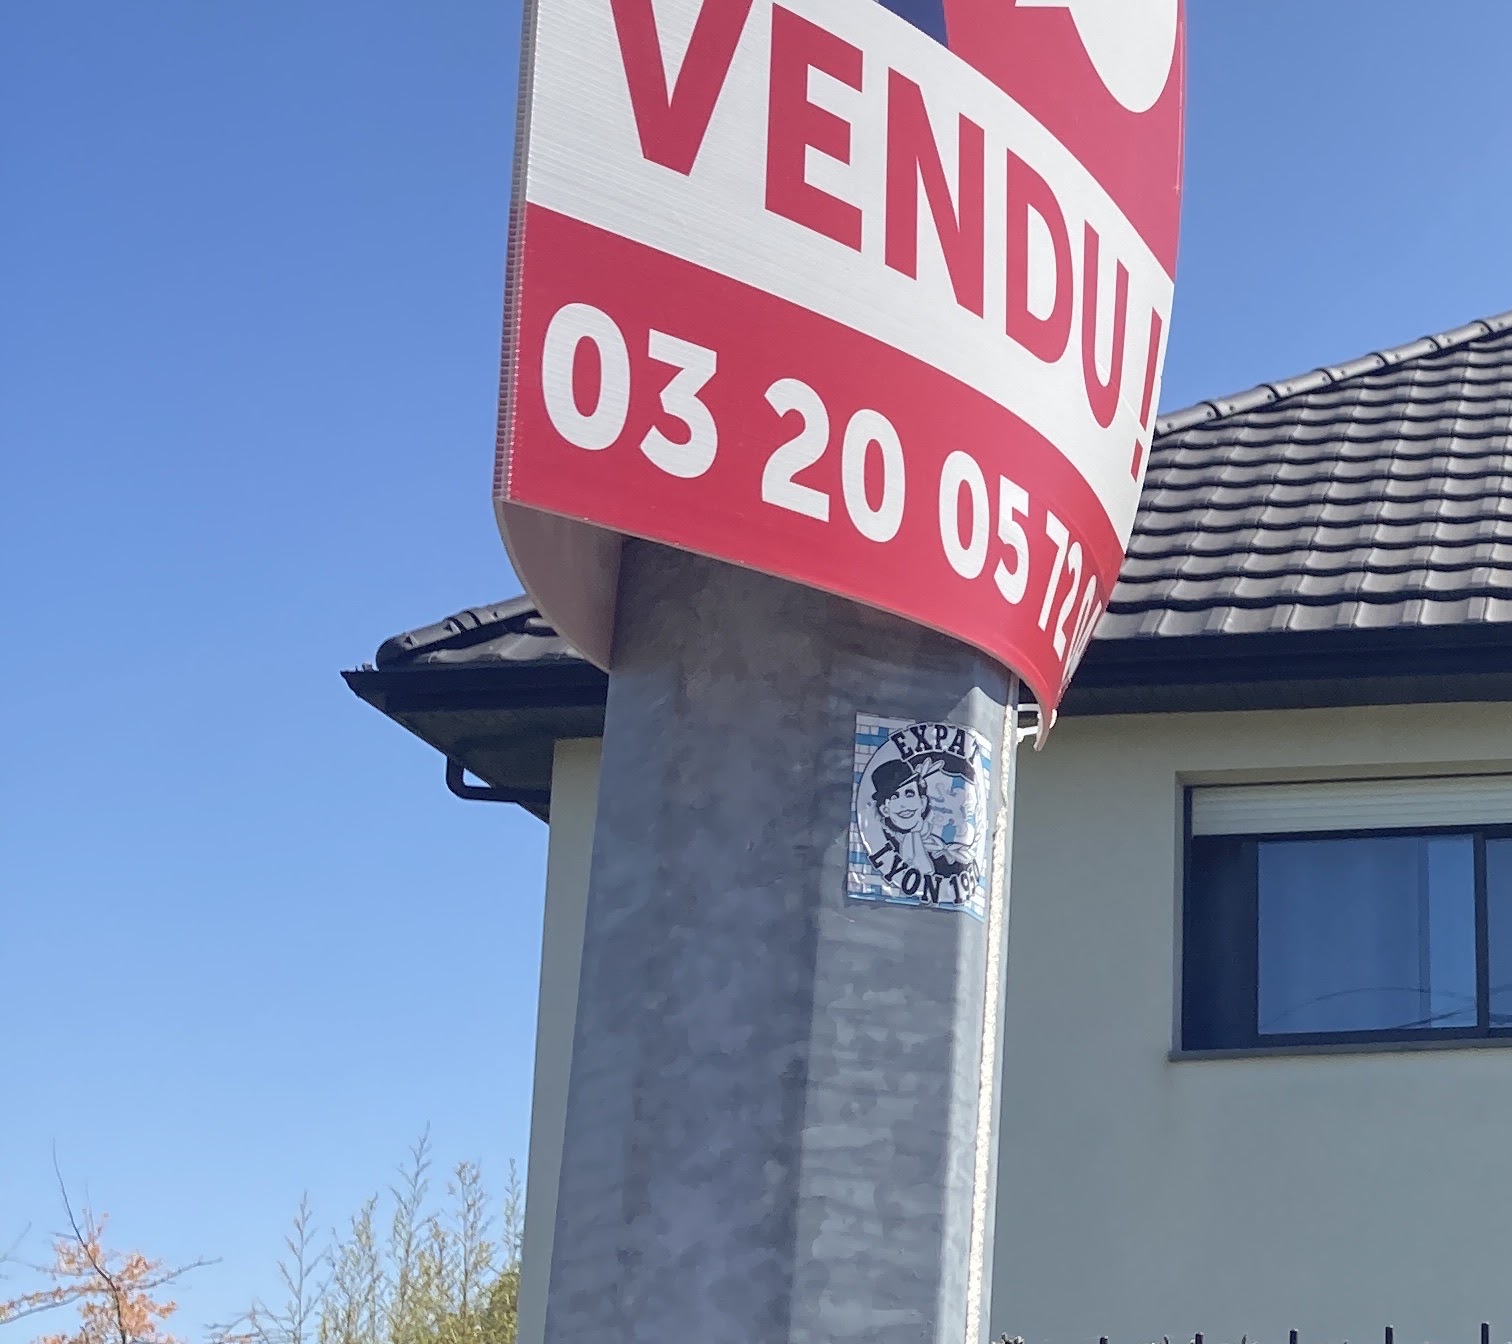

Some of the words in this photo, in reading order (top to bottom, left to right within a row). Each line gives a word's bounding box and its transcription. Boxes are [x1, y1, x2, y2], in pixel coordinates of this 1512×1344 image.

[541, 301, 719, 480] 03
[761, 377, 906, 544] 20
[938, 450, 1030, 605] 05
[868, 842, 944, 904] LYON
